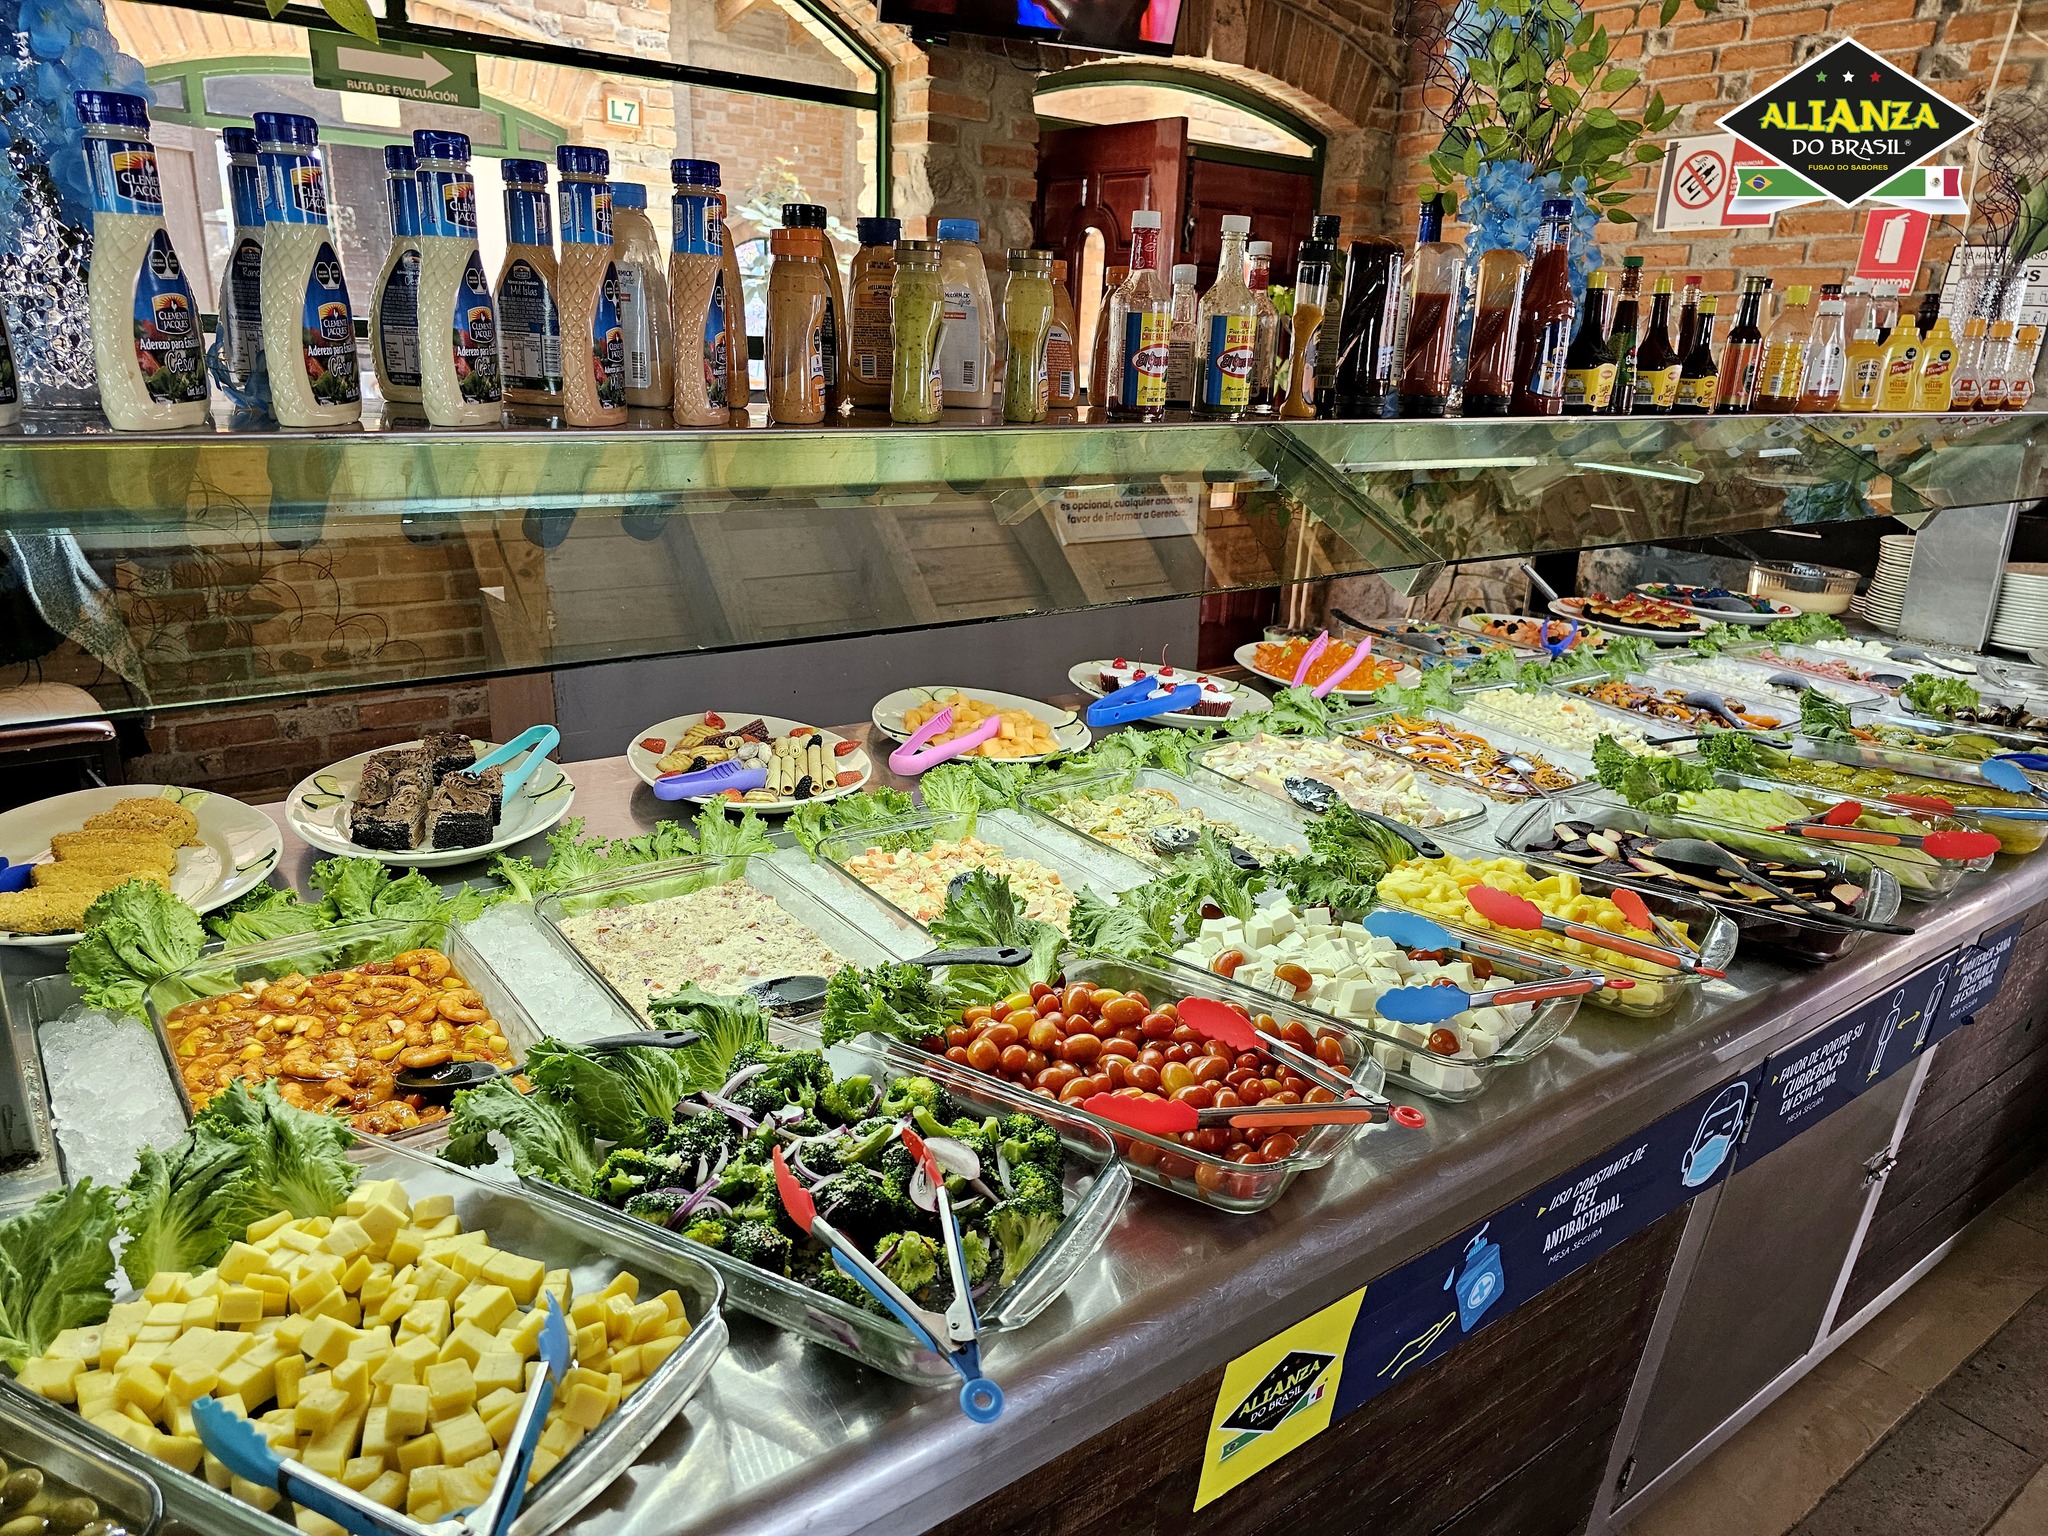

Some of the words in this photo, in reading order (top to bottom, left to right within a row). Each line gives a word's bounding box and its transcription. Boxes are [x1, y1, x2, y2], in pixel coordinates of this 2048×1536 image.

[346, 79, 375, 91] RUTA
[376, 83, 391, 94] DE
[393, 86, 459, 103] EVACUACIÓN
[611, 100, 636, 122] L7
[243, 266, 260, 277] Ranc
[158, 311, 189, 321] CLEMENTE
[162, 319, 188, 331] JACQUES
[323, 319, 347, 328] CLEMENTE
[327, 326, 347, 338] JACQUES
[140, 338, 170, 350] Aderezo
[171, 340, 184, 351] para
[308, 345, 332, 356] Aderezo
[457, 346, 479, 357] Aderezo
[1060, 502, 1071, 511] es
[1072, 499, 1113, 513] opcional,
[1114, 497, 1154, 510] cualquier
[1067, 515, 1091, 524] favor
[1092, 512, 1104, 522] de
[1105, 510, 1142, 522] informar
[1143, 511, 1150, 519] a
[1958, 956, 2001, 991] DISTANCIA
[1779, 1056, 1808, 1084] FAVOR
[1807, 1048, 1821, 1067] DE
[1819, 1029, 1853, 1060] PORTAR
[1851, 1021, 1866, 1041] SU
[1782, 1046, 1850, 1099] CUBREBOCAS
[1779, 1096, 1794, 1116] EN
[1792, 1084, 1814, 1109] ESTA
[1548, 1187, 1573, 1212] USO
[1572, 1152, 1633, 1199] CONSTANTE
[1630, 1143, 1649, 1165] DE
[1572, 1186, 1598, 1217] GEL
[1542, 1193, 1625, 1254] ANTIBACTERIAL.
[1547, 1246, 1570, 1267] MESA
[1571, 1227, 1603, 1252] SEGURA
[1238, 1360, 1321, 1419] ALIANZA
[1250, 1406, 1267, 1423] DO
[1268, 1385, 1304, 1412] BRASIL
